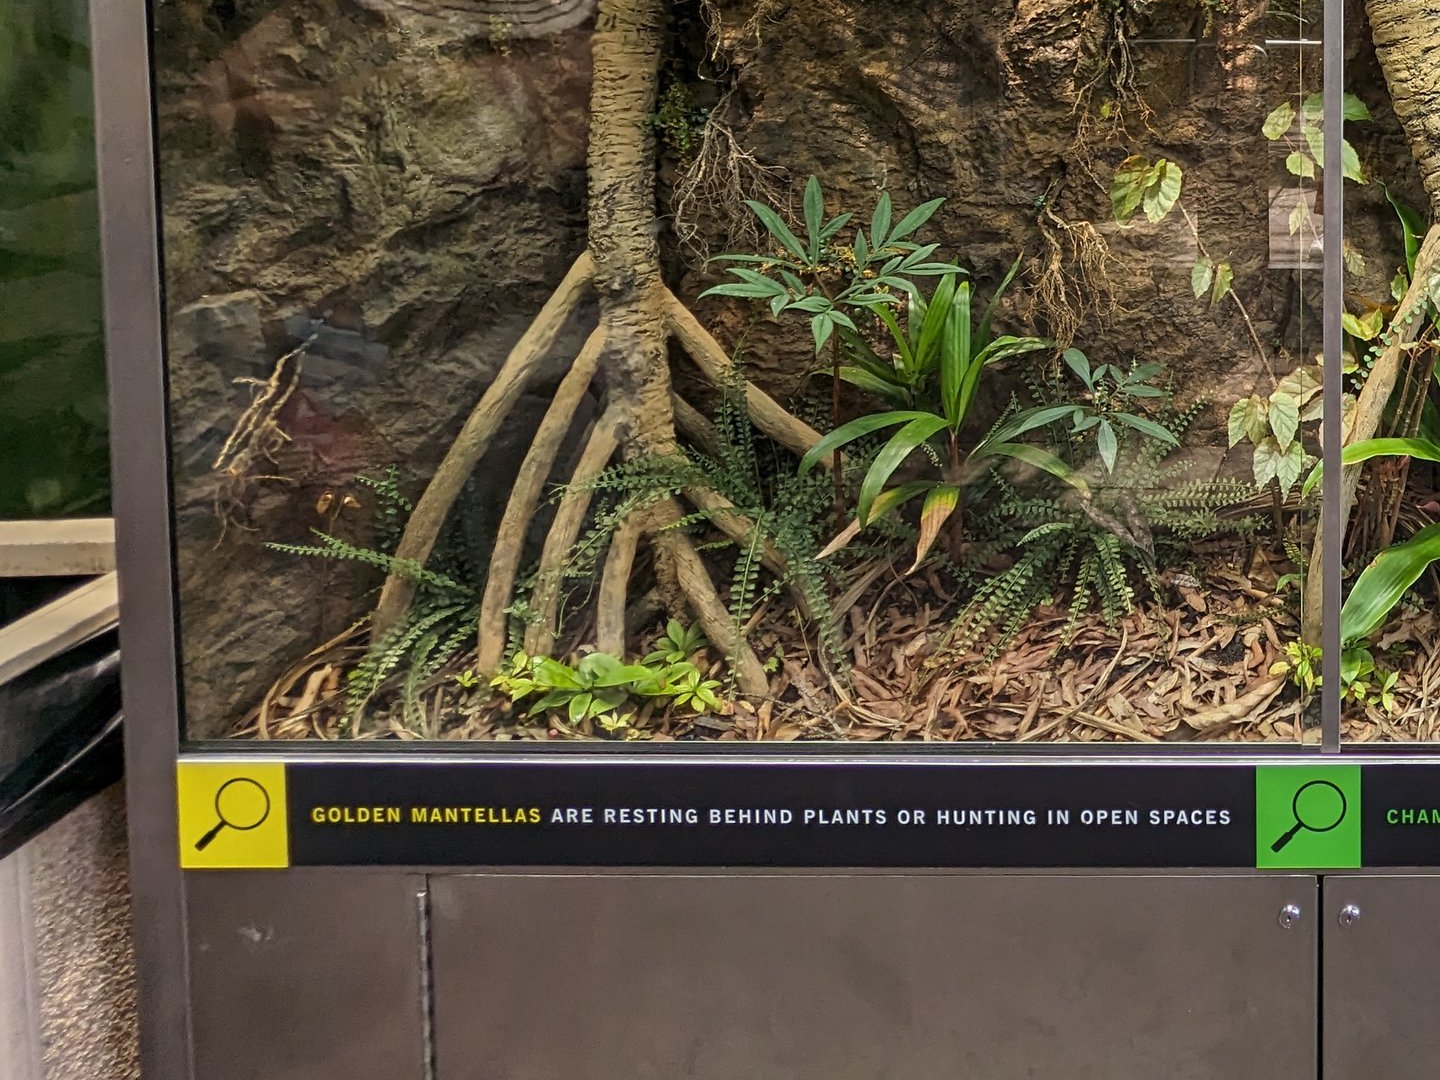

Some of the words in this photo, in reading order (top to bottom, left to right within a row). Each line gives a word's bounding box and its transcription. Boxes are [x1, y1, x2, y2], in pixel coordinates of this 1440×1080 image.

[312, 807, 400, 823] GOLDEN
[411, 807, 540, 823] MANTELLAS
[551, 807, 593, 823] ARE
[604, 808, 698, 823] RESTING
[709, 808, 792, 824] BEHIND
[804, 809, 886, 824] PLANTS
[897, 809, 925, 824] OR
[937, 809, 1036, 825] HUNTING
[1048, 810, 1068, 825] IN
[1080, 809, 1138, 825] OPEN
[1149, 809, 1230, 825] SPACES
